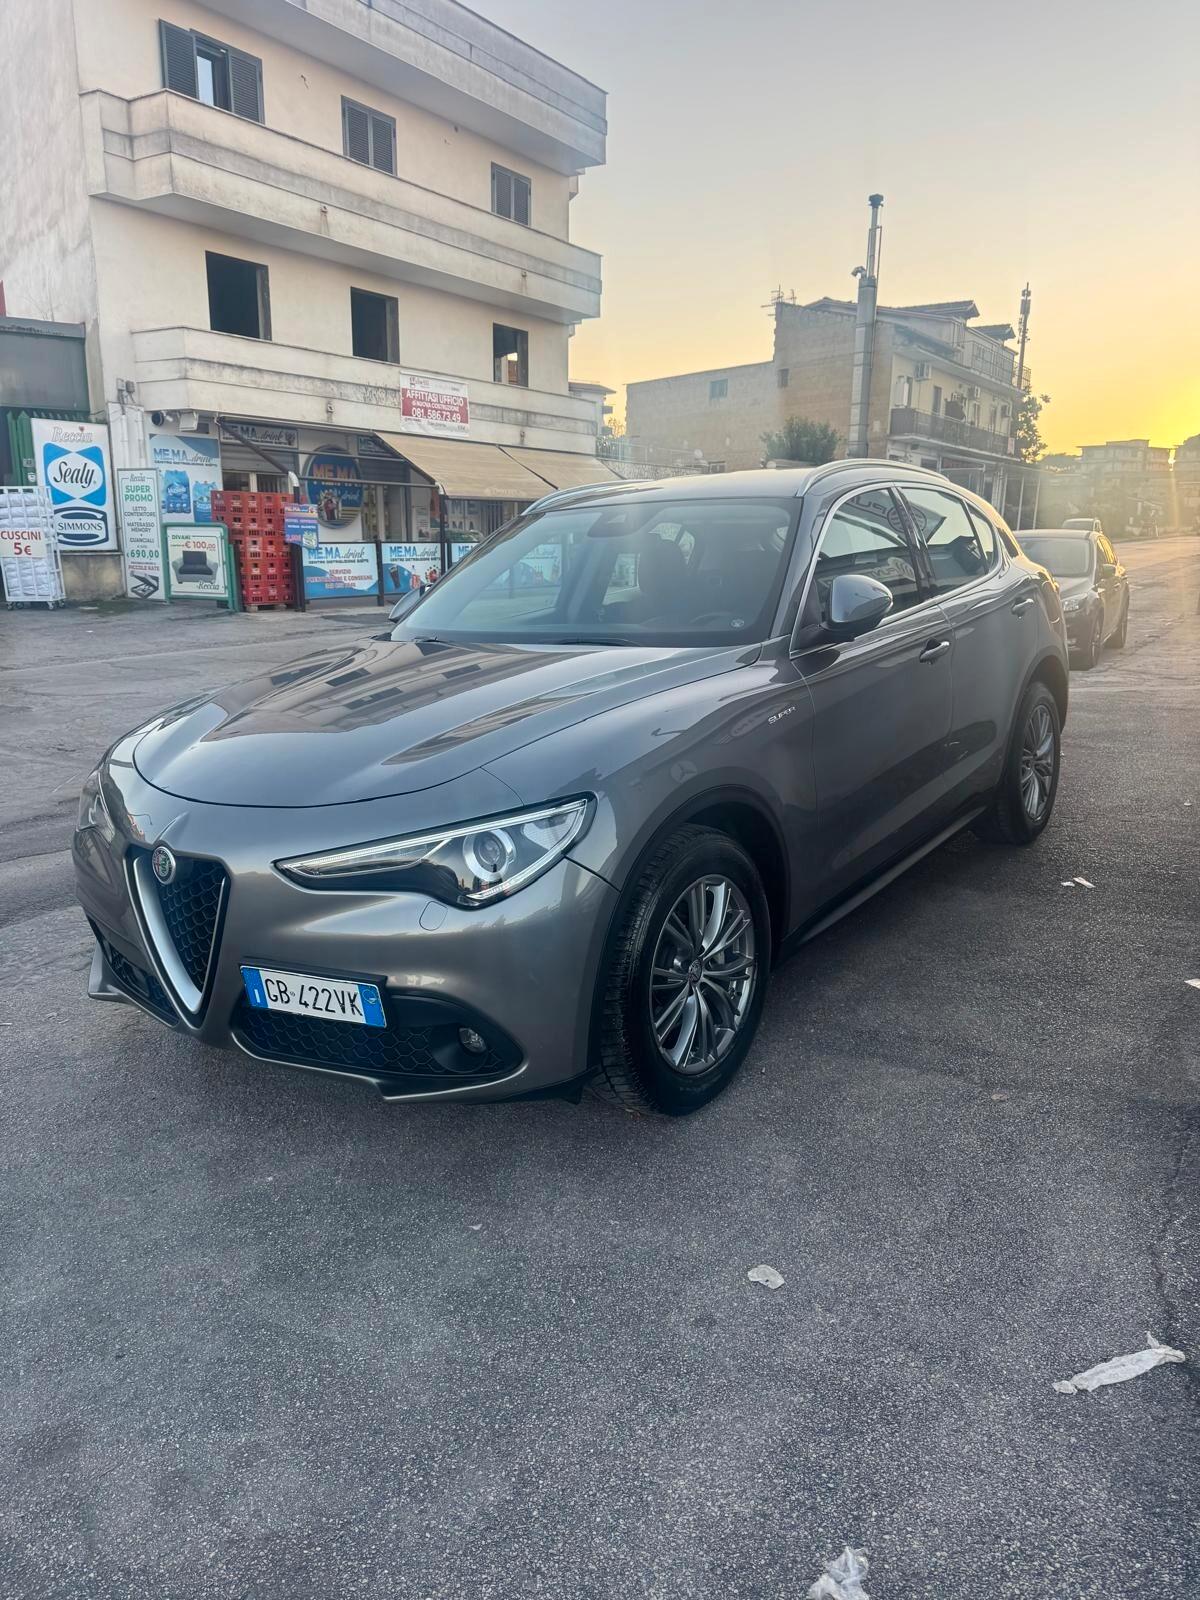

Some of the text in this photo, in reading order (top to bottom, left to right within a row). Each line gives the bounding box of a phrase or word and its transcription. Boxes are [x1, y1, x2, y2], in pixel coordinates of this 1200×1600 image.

[406, 389, 464, 407] AFFITTASI UFFICIO
[53, 461, 95, 488] Sealy
[125, 484, 151, 494] SUPER
[124, 494, 153, 502] PROMO
[58, 522, 103, 531] SIMMONS
[0, 530, 42, 541] CUSCINI
[768, 705, 797, 725] SUPER
[298, 984, 363, 1017] 422VK
